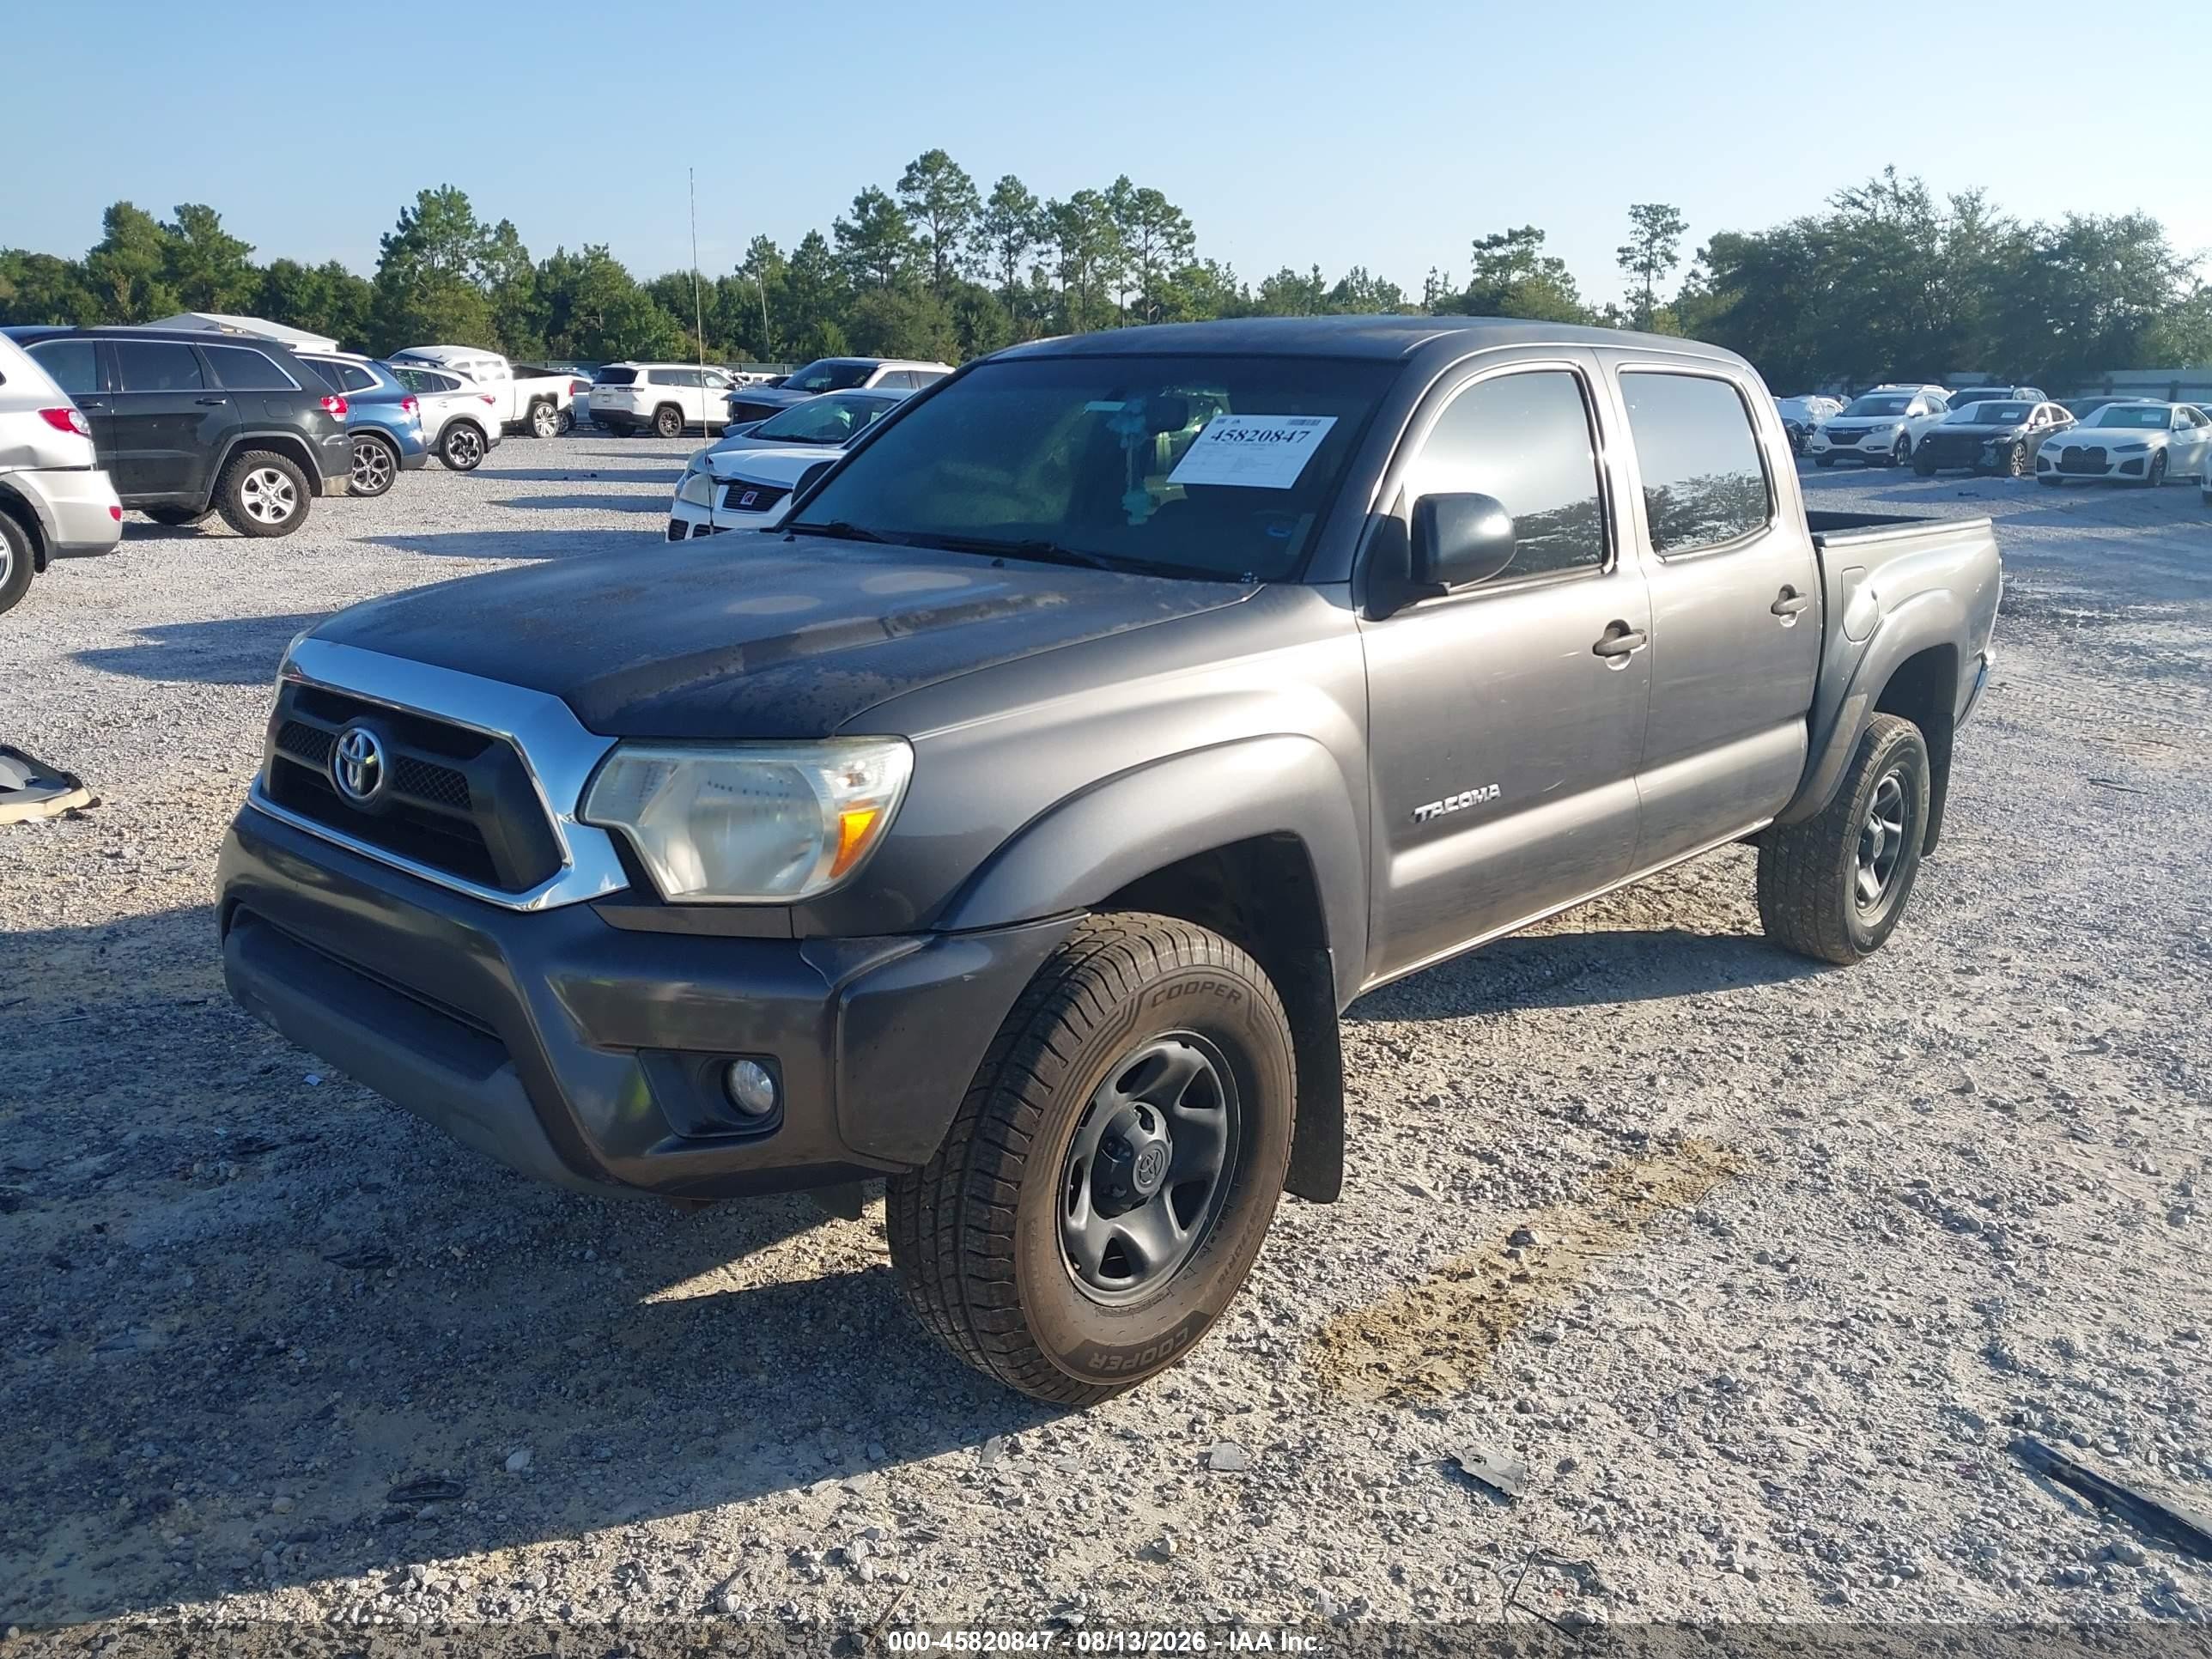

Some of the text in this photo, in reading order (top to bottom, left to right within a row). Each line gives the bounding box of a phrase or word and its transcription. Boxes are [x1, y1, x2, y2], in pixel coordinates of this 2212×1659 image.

[1210, 428, 1312, 444] 45820847
[1409, 783, 1502, 824] TACOMA
[1151, 981, 1243, 1009] COOPER
[1087, 1327, 1189, 1370] COOPER
